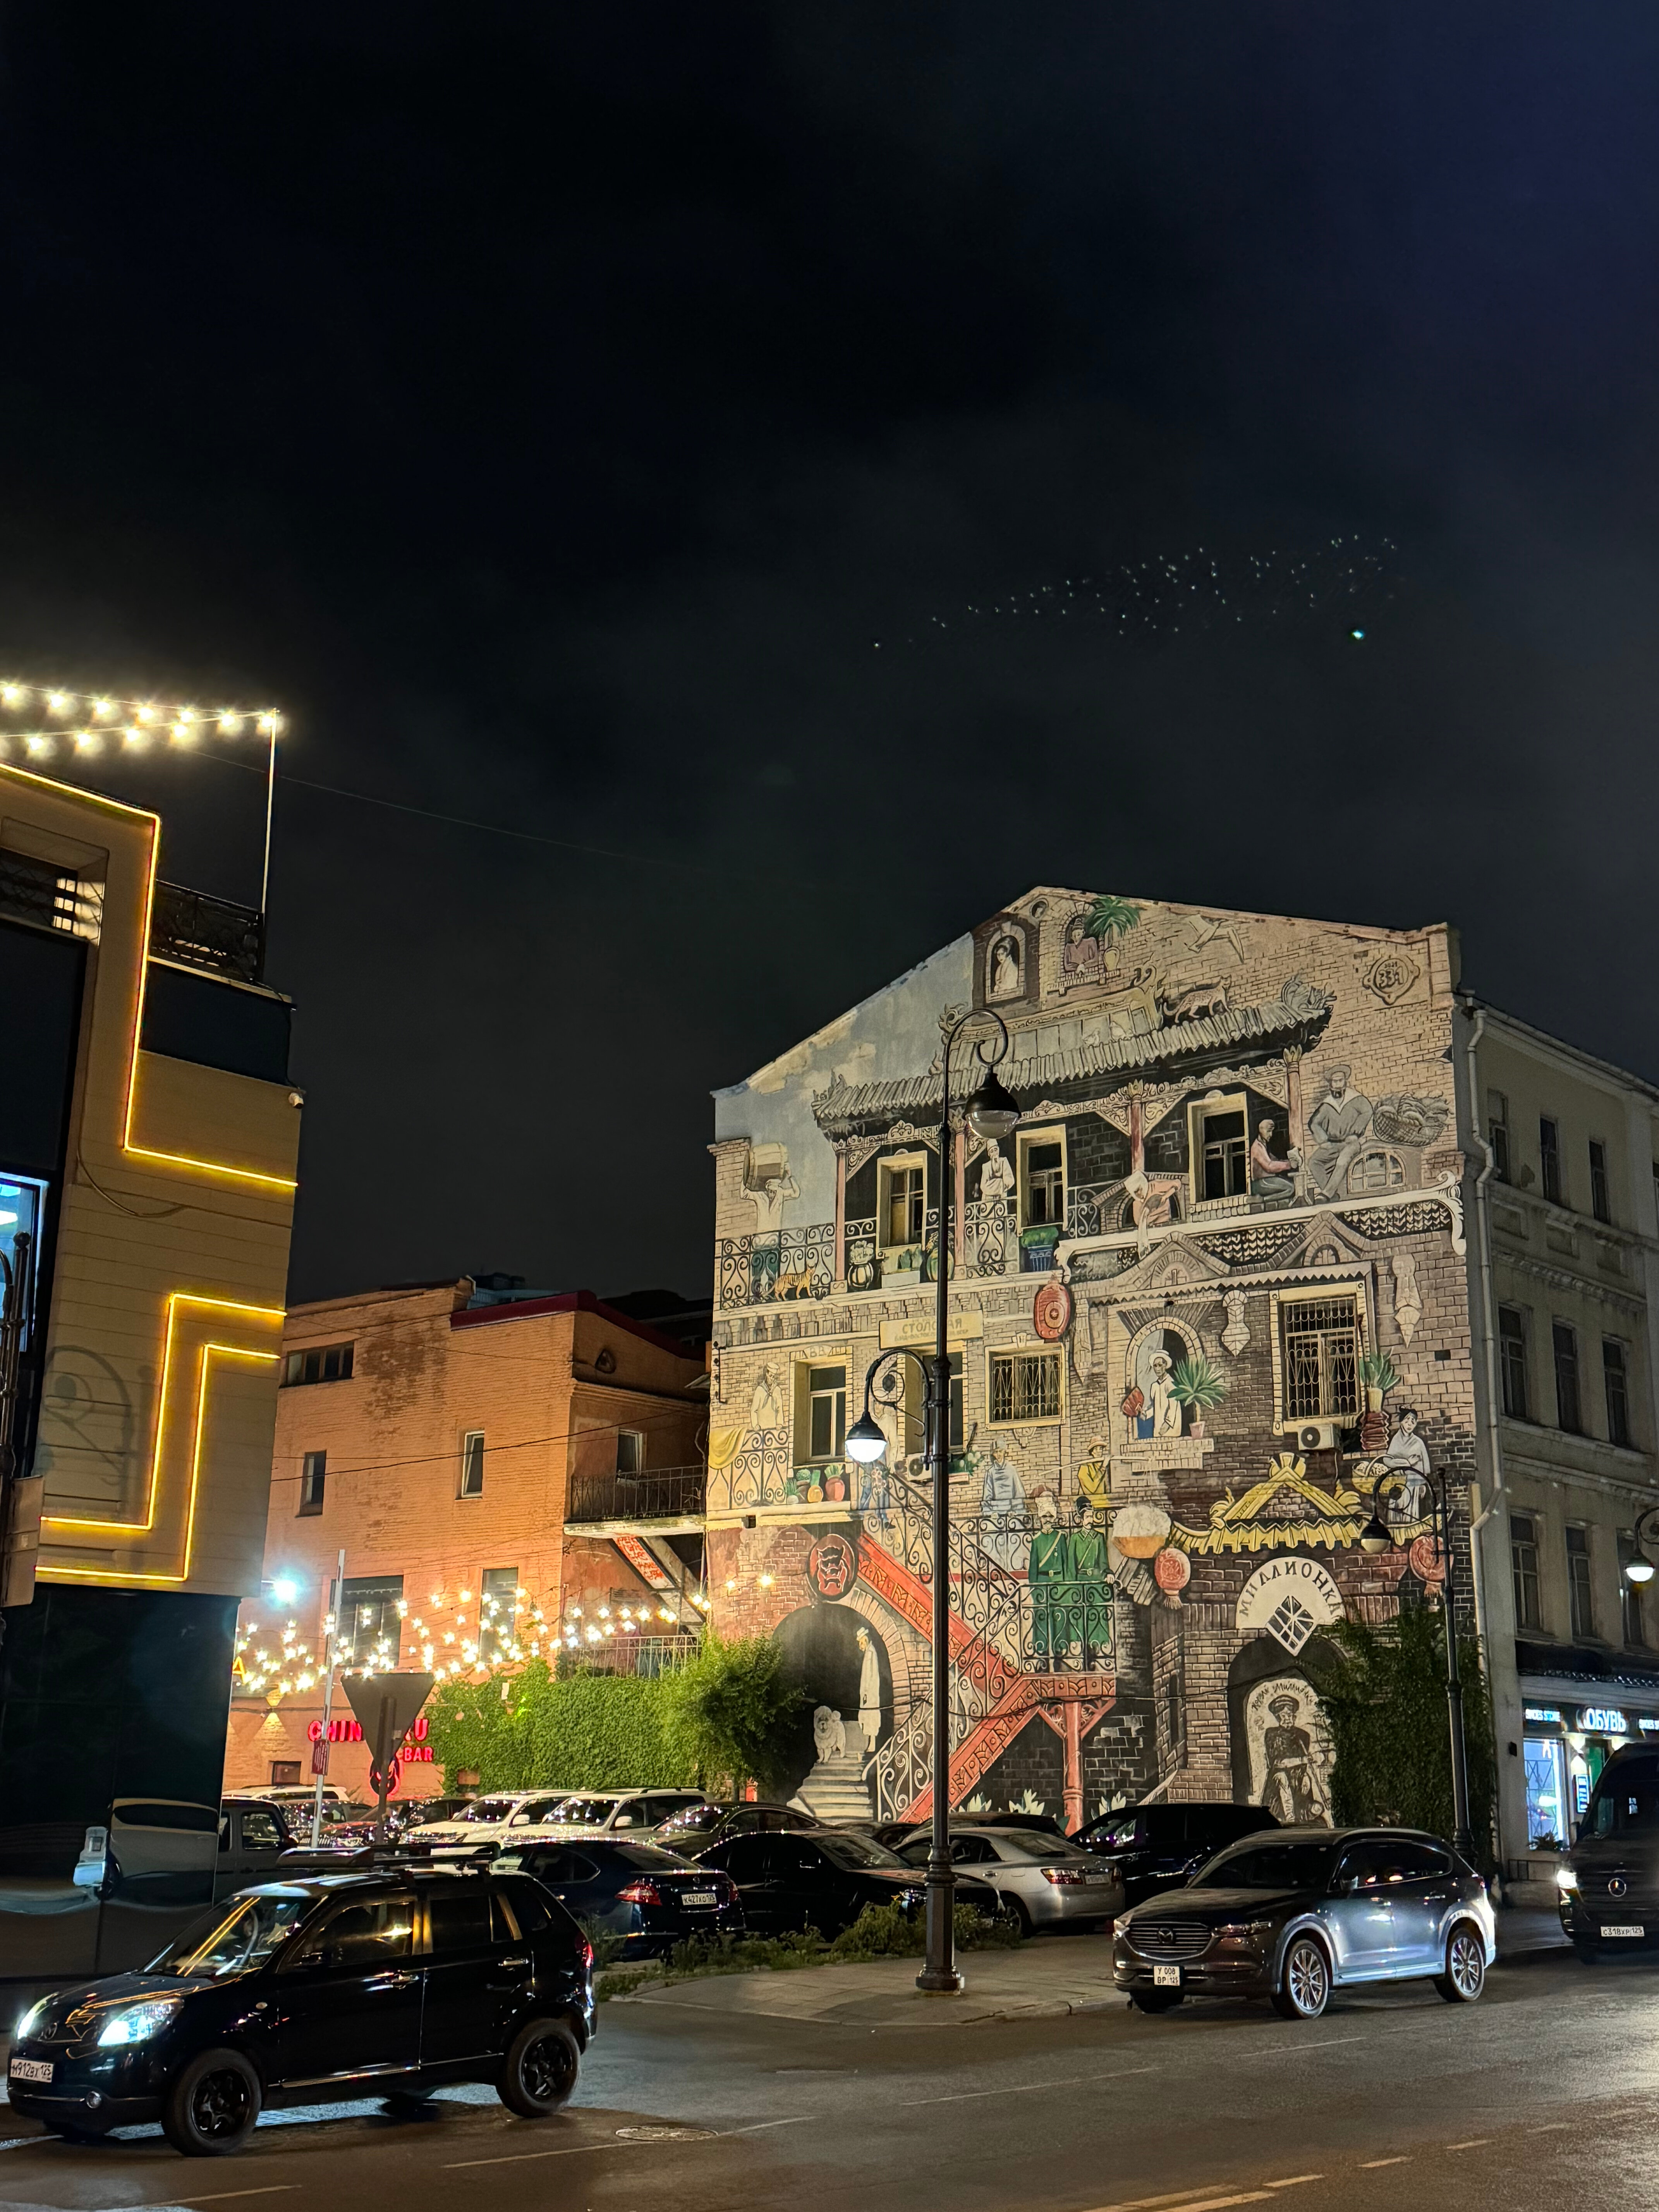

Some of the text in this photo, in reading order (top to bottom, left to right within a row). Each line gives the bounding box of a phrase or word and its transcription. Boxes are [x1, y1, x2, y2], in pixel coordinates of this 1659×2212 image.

[902, 1318, 962, 1334] СТОЛОАЯ
[1239, 1561, 1342, 1618] МИЛЛИОНКА
[1586, 1708, 1626, 1732] ОБУВЬ
[403, 1746, 433, 1762] BAR
